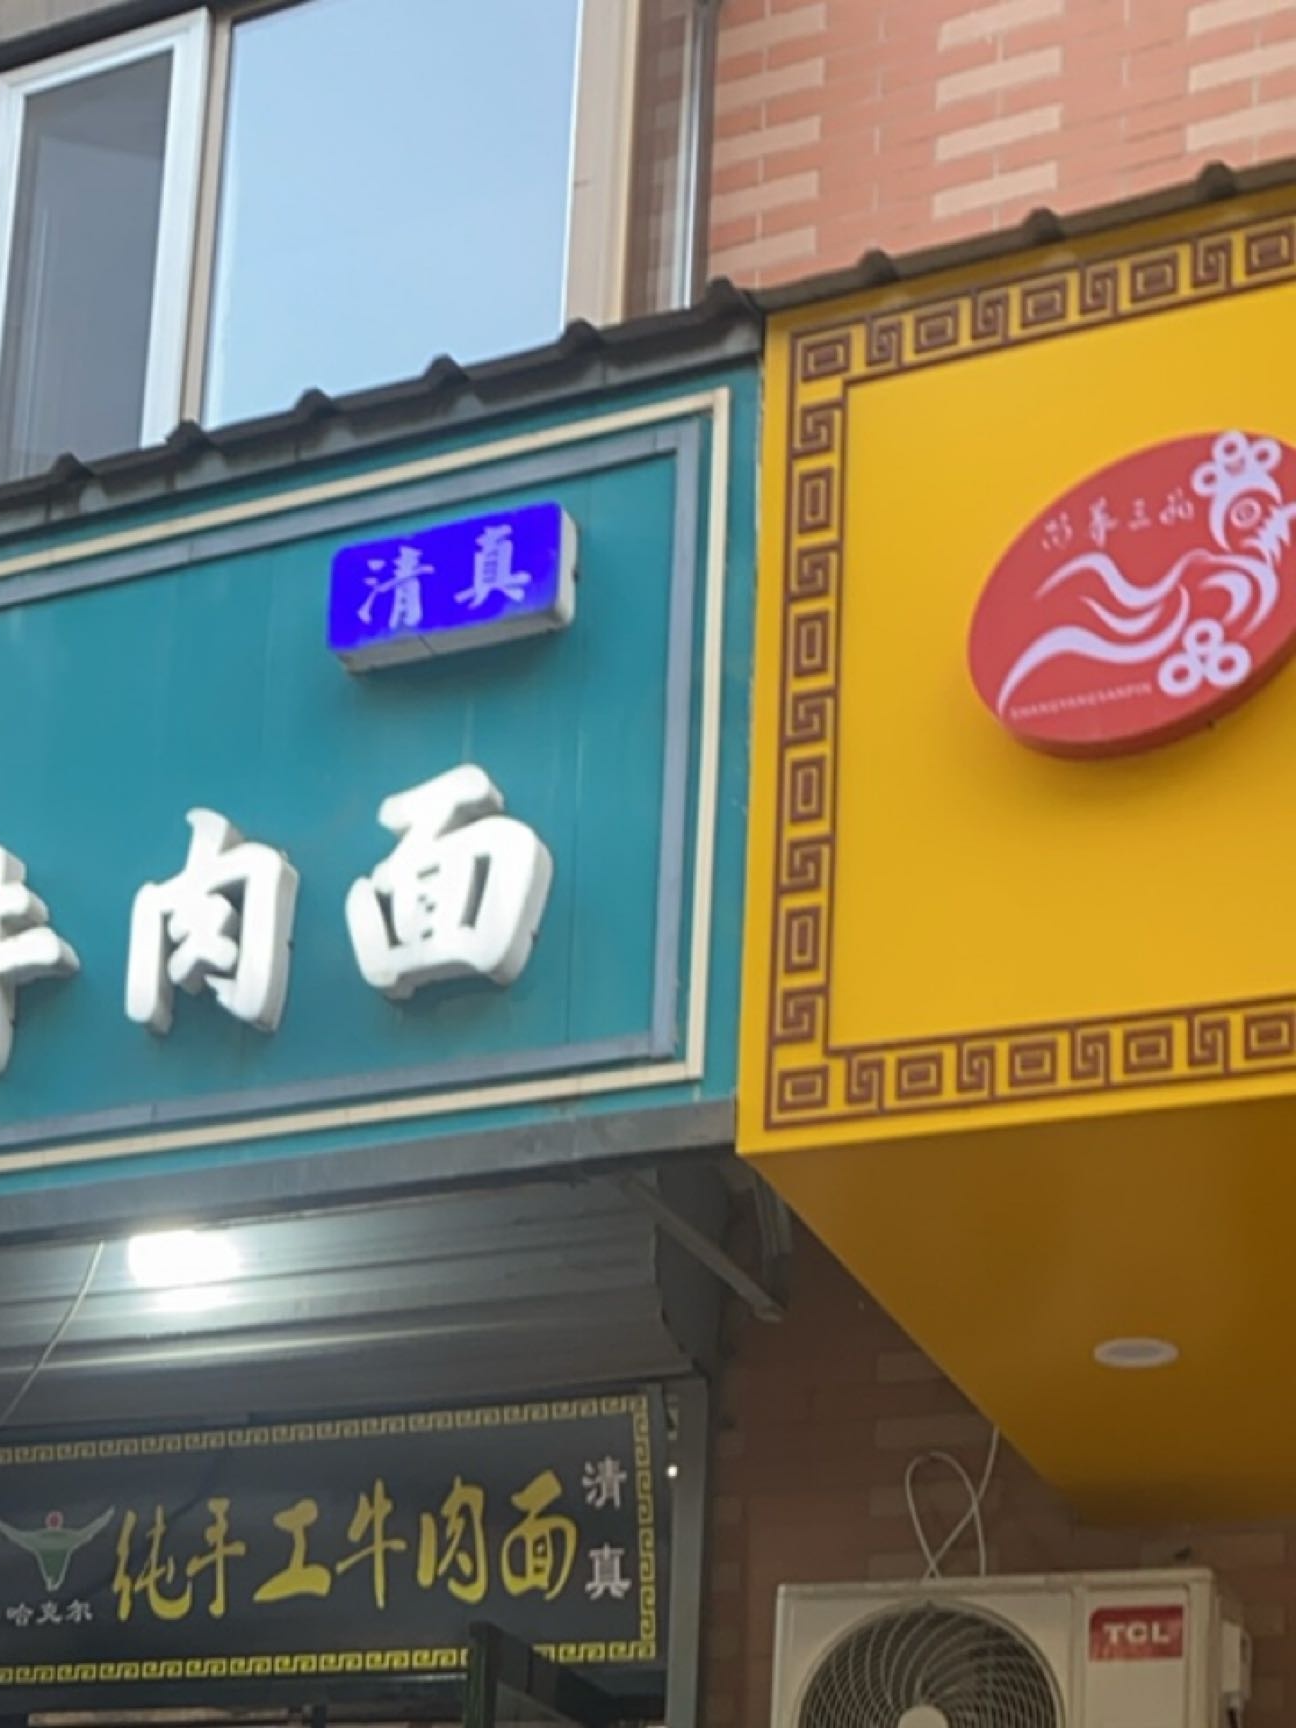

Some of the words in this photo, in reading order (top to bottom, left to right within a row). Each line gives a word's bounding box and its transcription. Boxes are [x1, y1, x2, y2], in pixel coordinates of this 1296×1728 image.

[357, 525, 531, 628] 清真
[112, 1470, 578, 1621] 纯手工牛肉面
[582, 1455, 632, 1600] 清真
[1104, 1623, 1169, 1644] TCL
